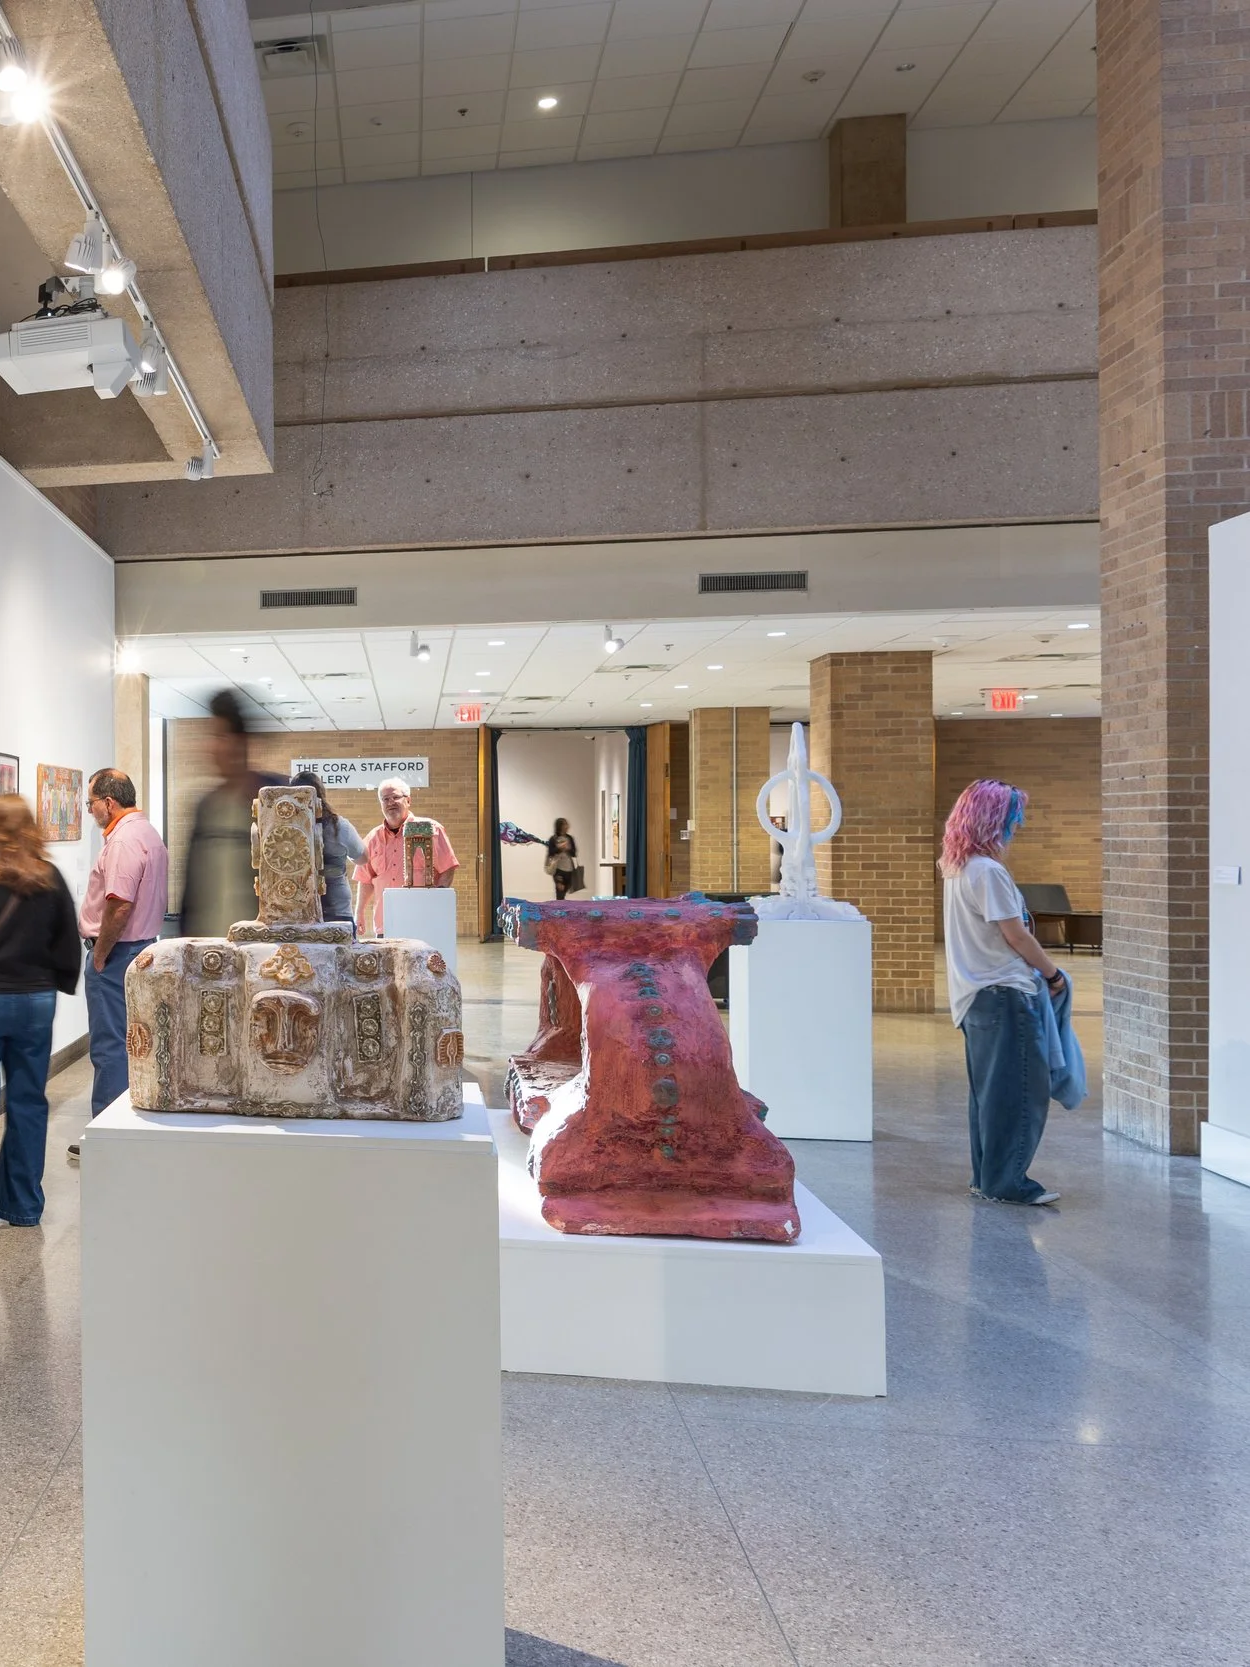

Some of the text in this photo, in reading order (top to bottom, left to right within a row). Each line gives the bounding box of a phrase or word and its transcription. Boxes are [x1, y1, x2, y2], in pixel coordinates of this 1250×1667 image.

[991, 691, 1017, 709] EXIT
[460, 706, 480, 722] EXIT
[296, 761, 425, 773] THE CORA STAFFORD
[320, 775, 351, 784] LERY
